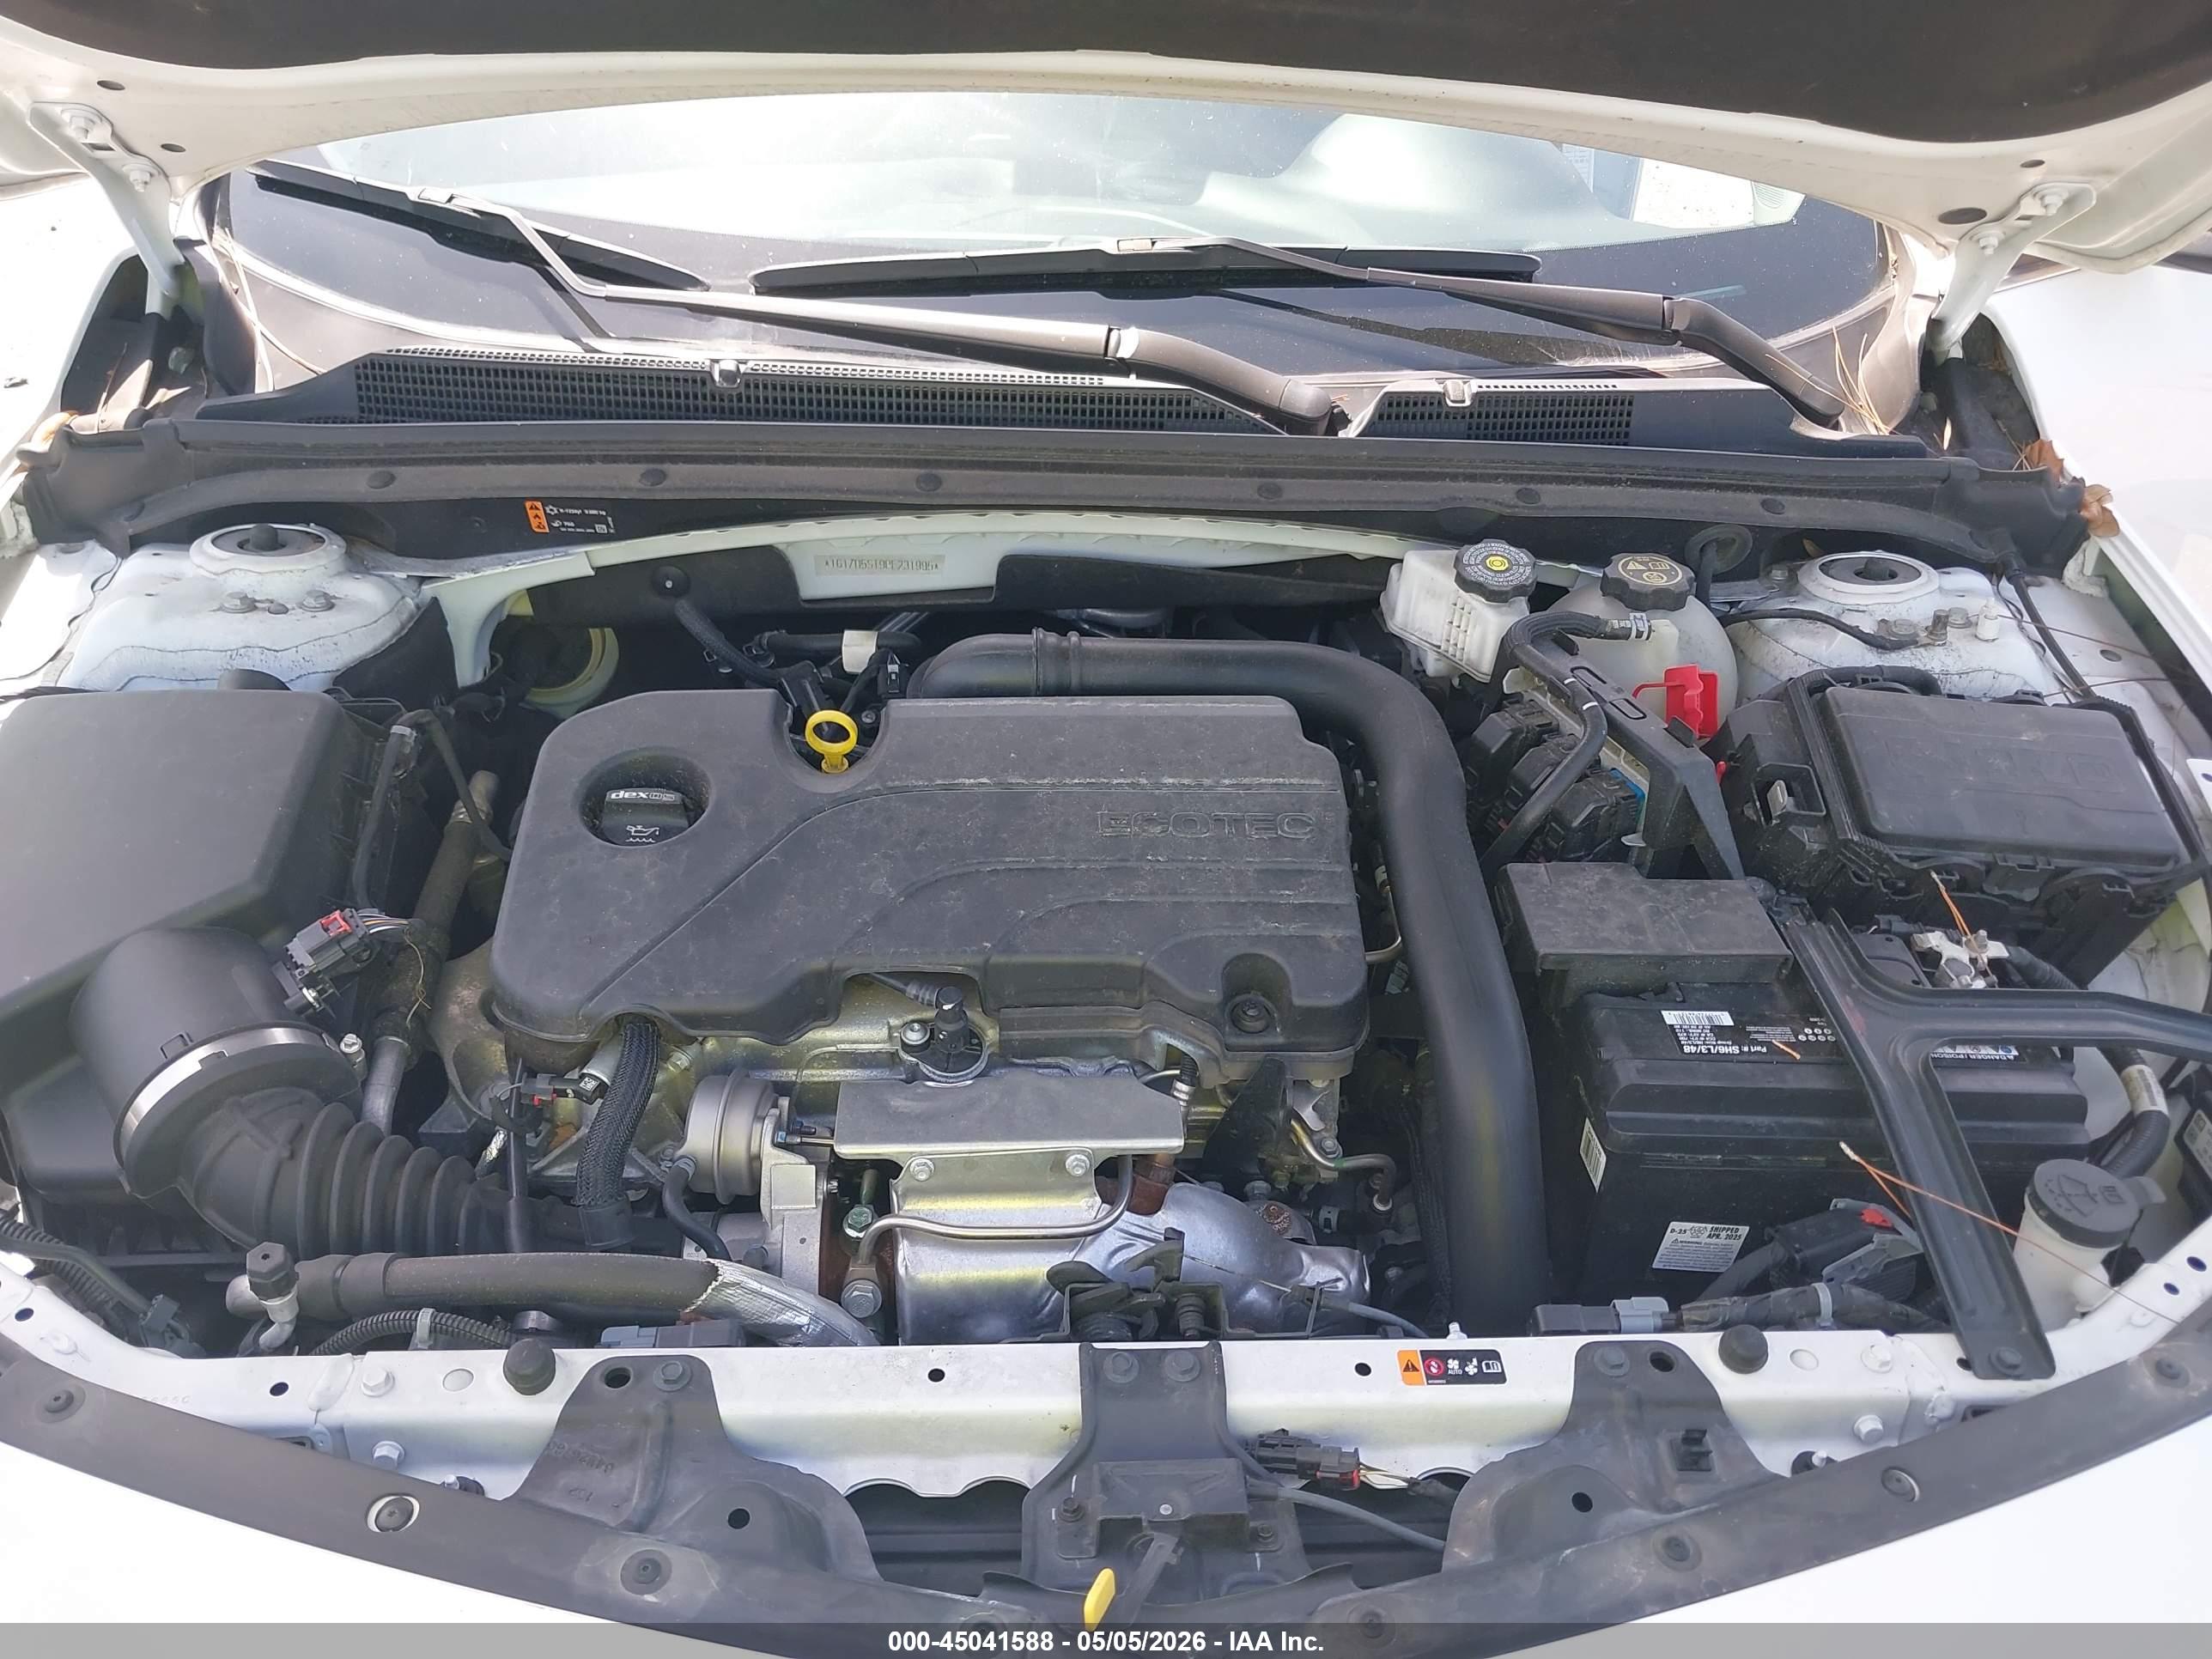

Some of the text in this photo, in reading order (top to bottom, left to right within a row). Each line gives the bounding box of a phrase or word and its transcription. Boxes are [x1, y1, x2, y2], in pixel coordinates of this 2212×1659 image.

[611, 791, 675, 801] dexos
[1097, 811, 1316, 838] ECOTEC
[1683, 1045, 1740, 1054] SH6/L3/48
